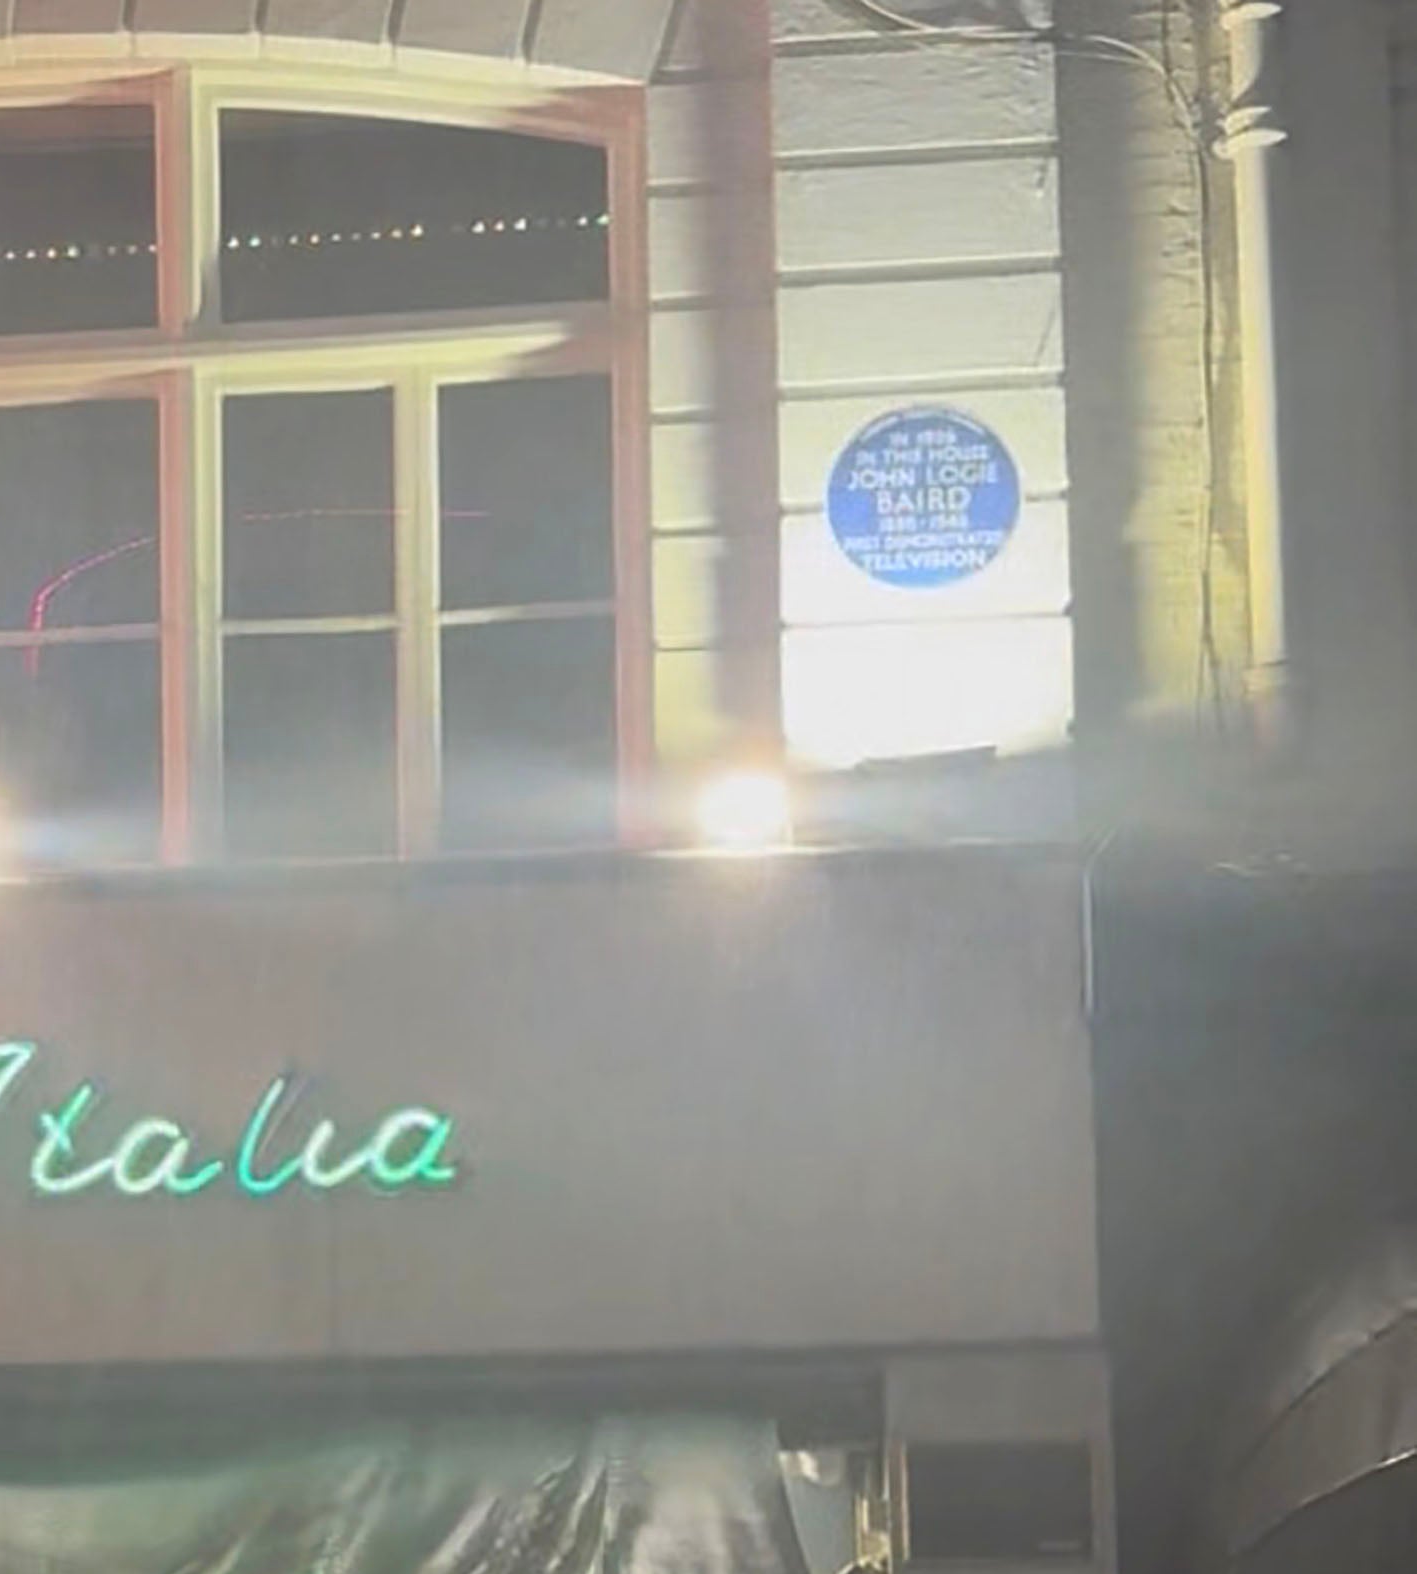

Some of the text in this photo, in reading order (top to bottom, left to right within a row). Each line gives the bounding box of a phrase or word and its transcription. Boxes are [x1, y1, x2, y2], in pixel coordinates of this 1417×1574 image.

[847, 462, 999, 491] JOHN LOGIE
[876, 485, 972, 515] BAIRD
[861, 548, 987, 572] TELEVISION
